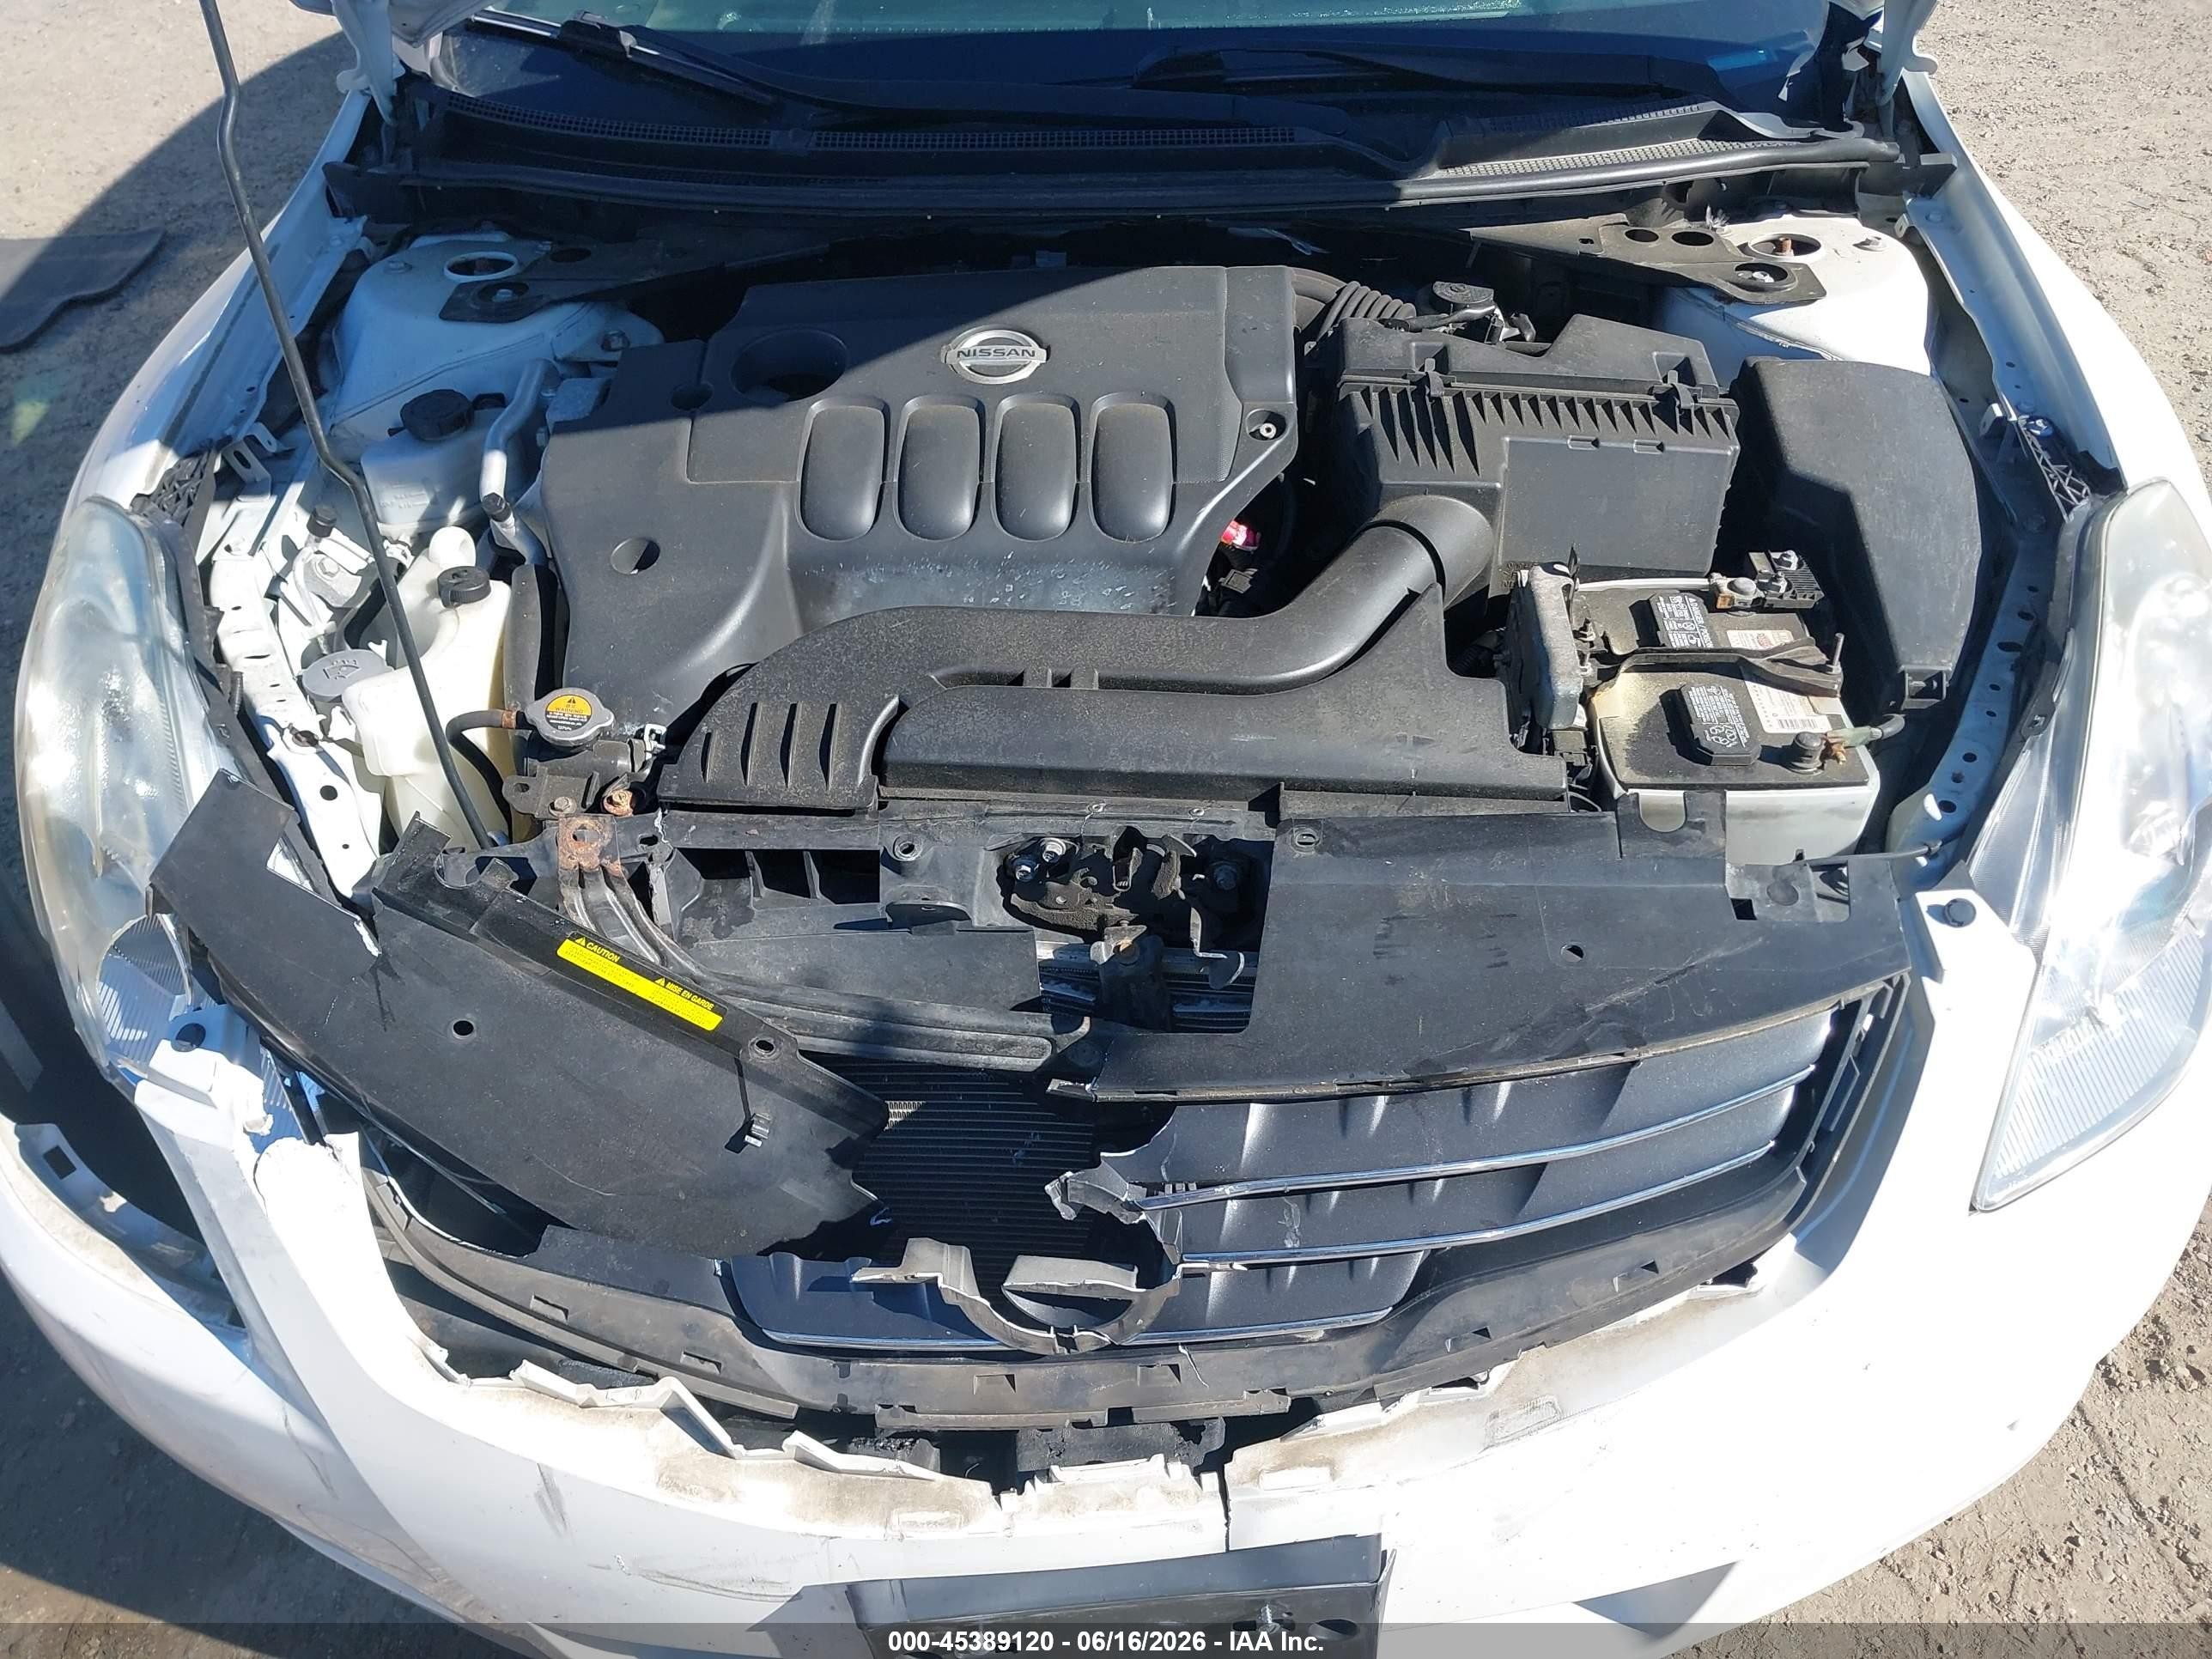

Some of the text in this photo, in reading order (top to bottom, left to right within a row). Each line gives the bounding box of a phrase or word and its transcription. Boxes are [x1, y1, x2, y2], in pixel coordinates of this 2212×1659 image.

[957, 348, 1036, 358] NISSAN
[1691, 602, 1705, 624] DANGER
[586, 942, 621, 963] CAUTION
[665, 981, 714, 1011] MISE EN GARDE
